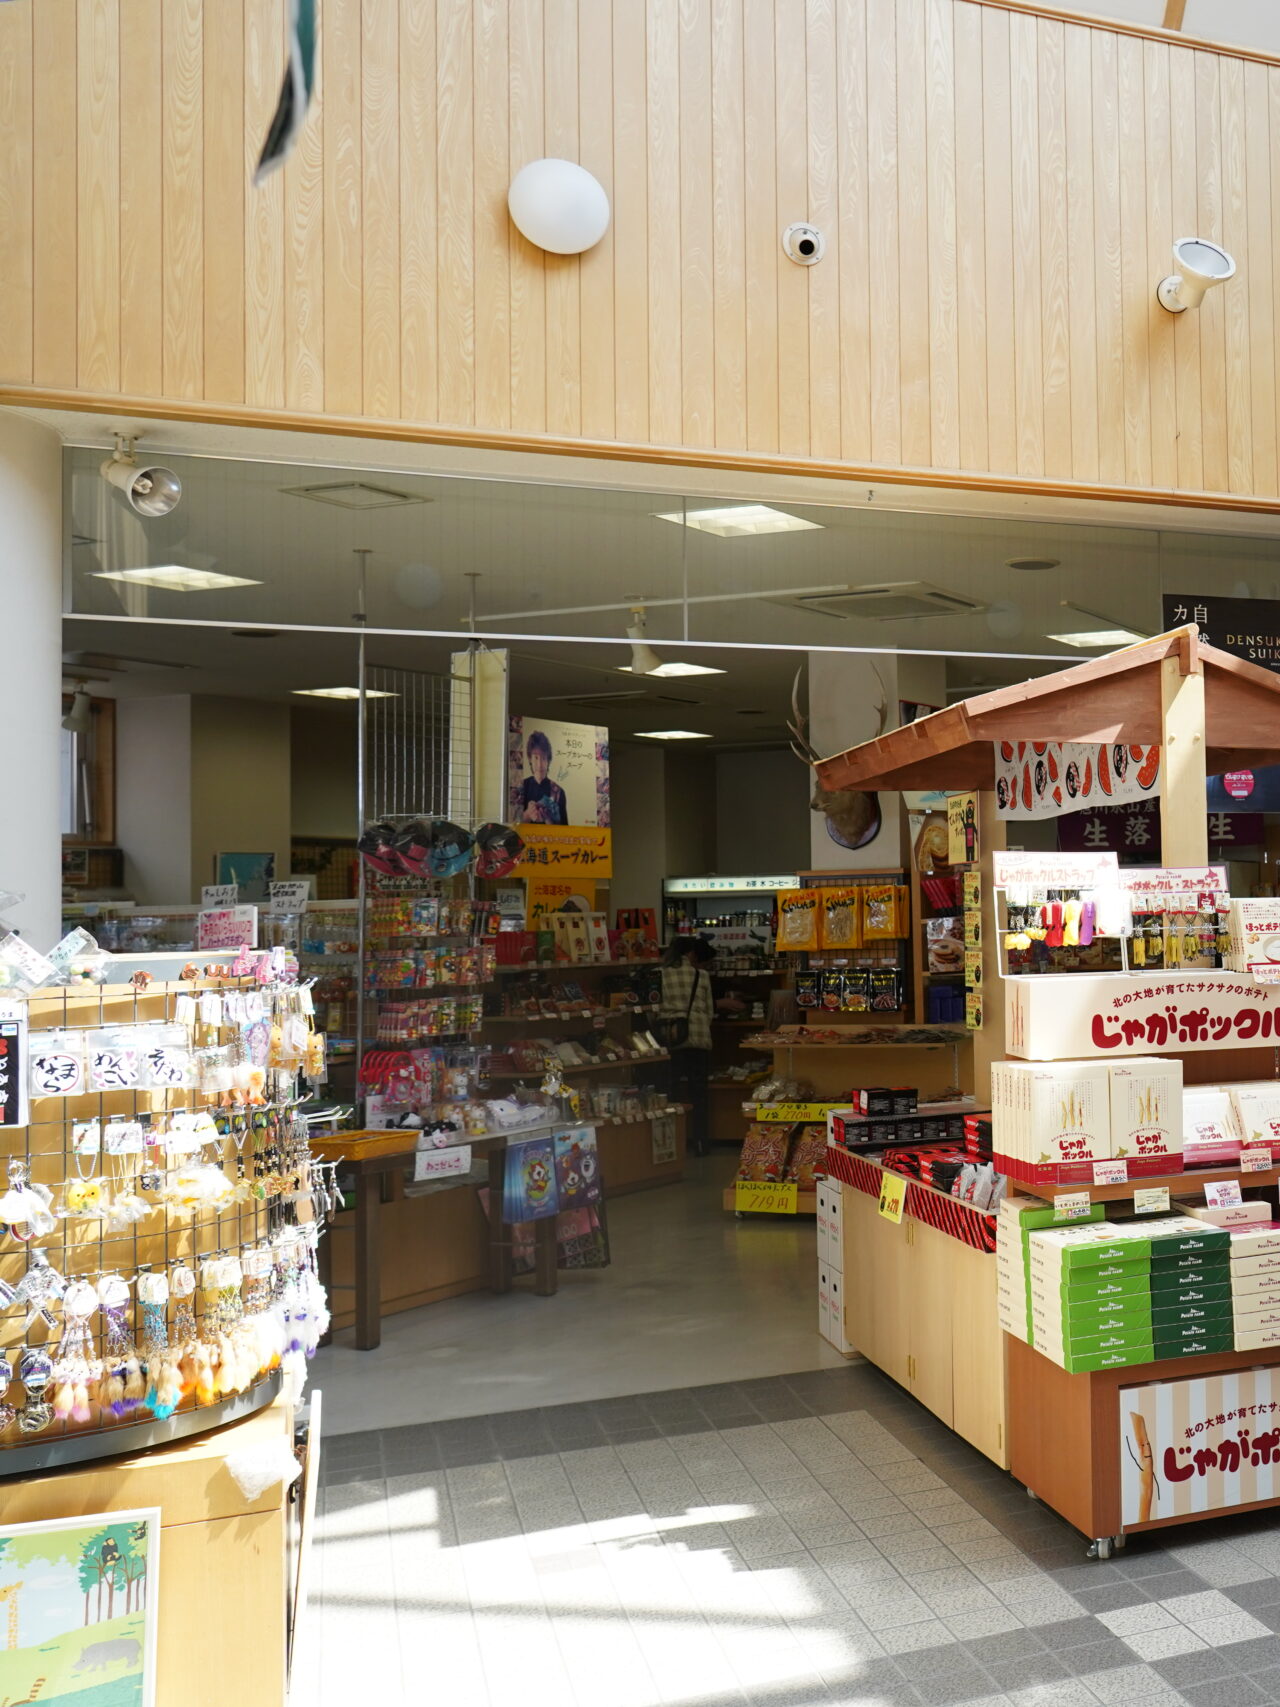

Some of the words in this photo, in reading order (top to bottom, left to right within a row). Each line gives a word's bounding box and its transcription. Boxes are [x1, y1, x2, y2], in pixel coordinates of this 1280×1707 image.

[521, 848, 609, 865] 海道スープカレー
[1112, 982, 1269, 1008] 北の大地が育てたサクサクのポテト
[1059, 1137, 1087, 1151] じゃが
[1136, 1131, 1162, 1145] じゃが
[1061, 1150, 1094, 1161] ポックル
[1138, 1143, 1168, 1155] ポックル
